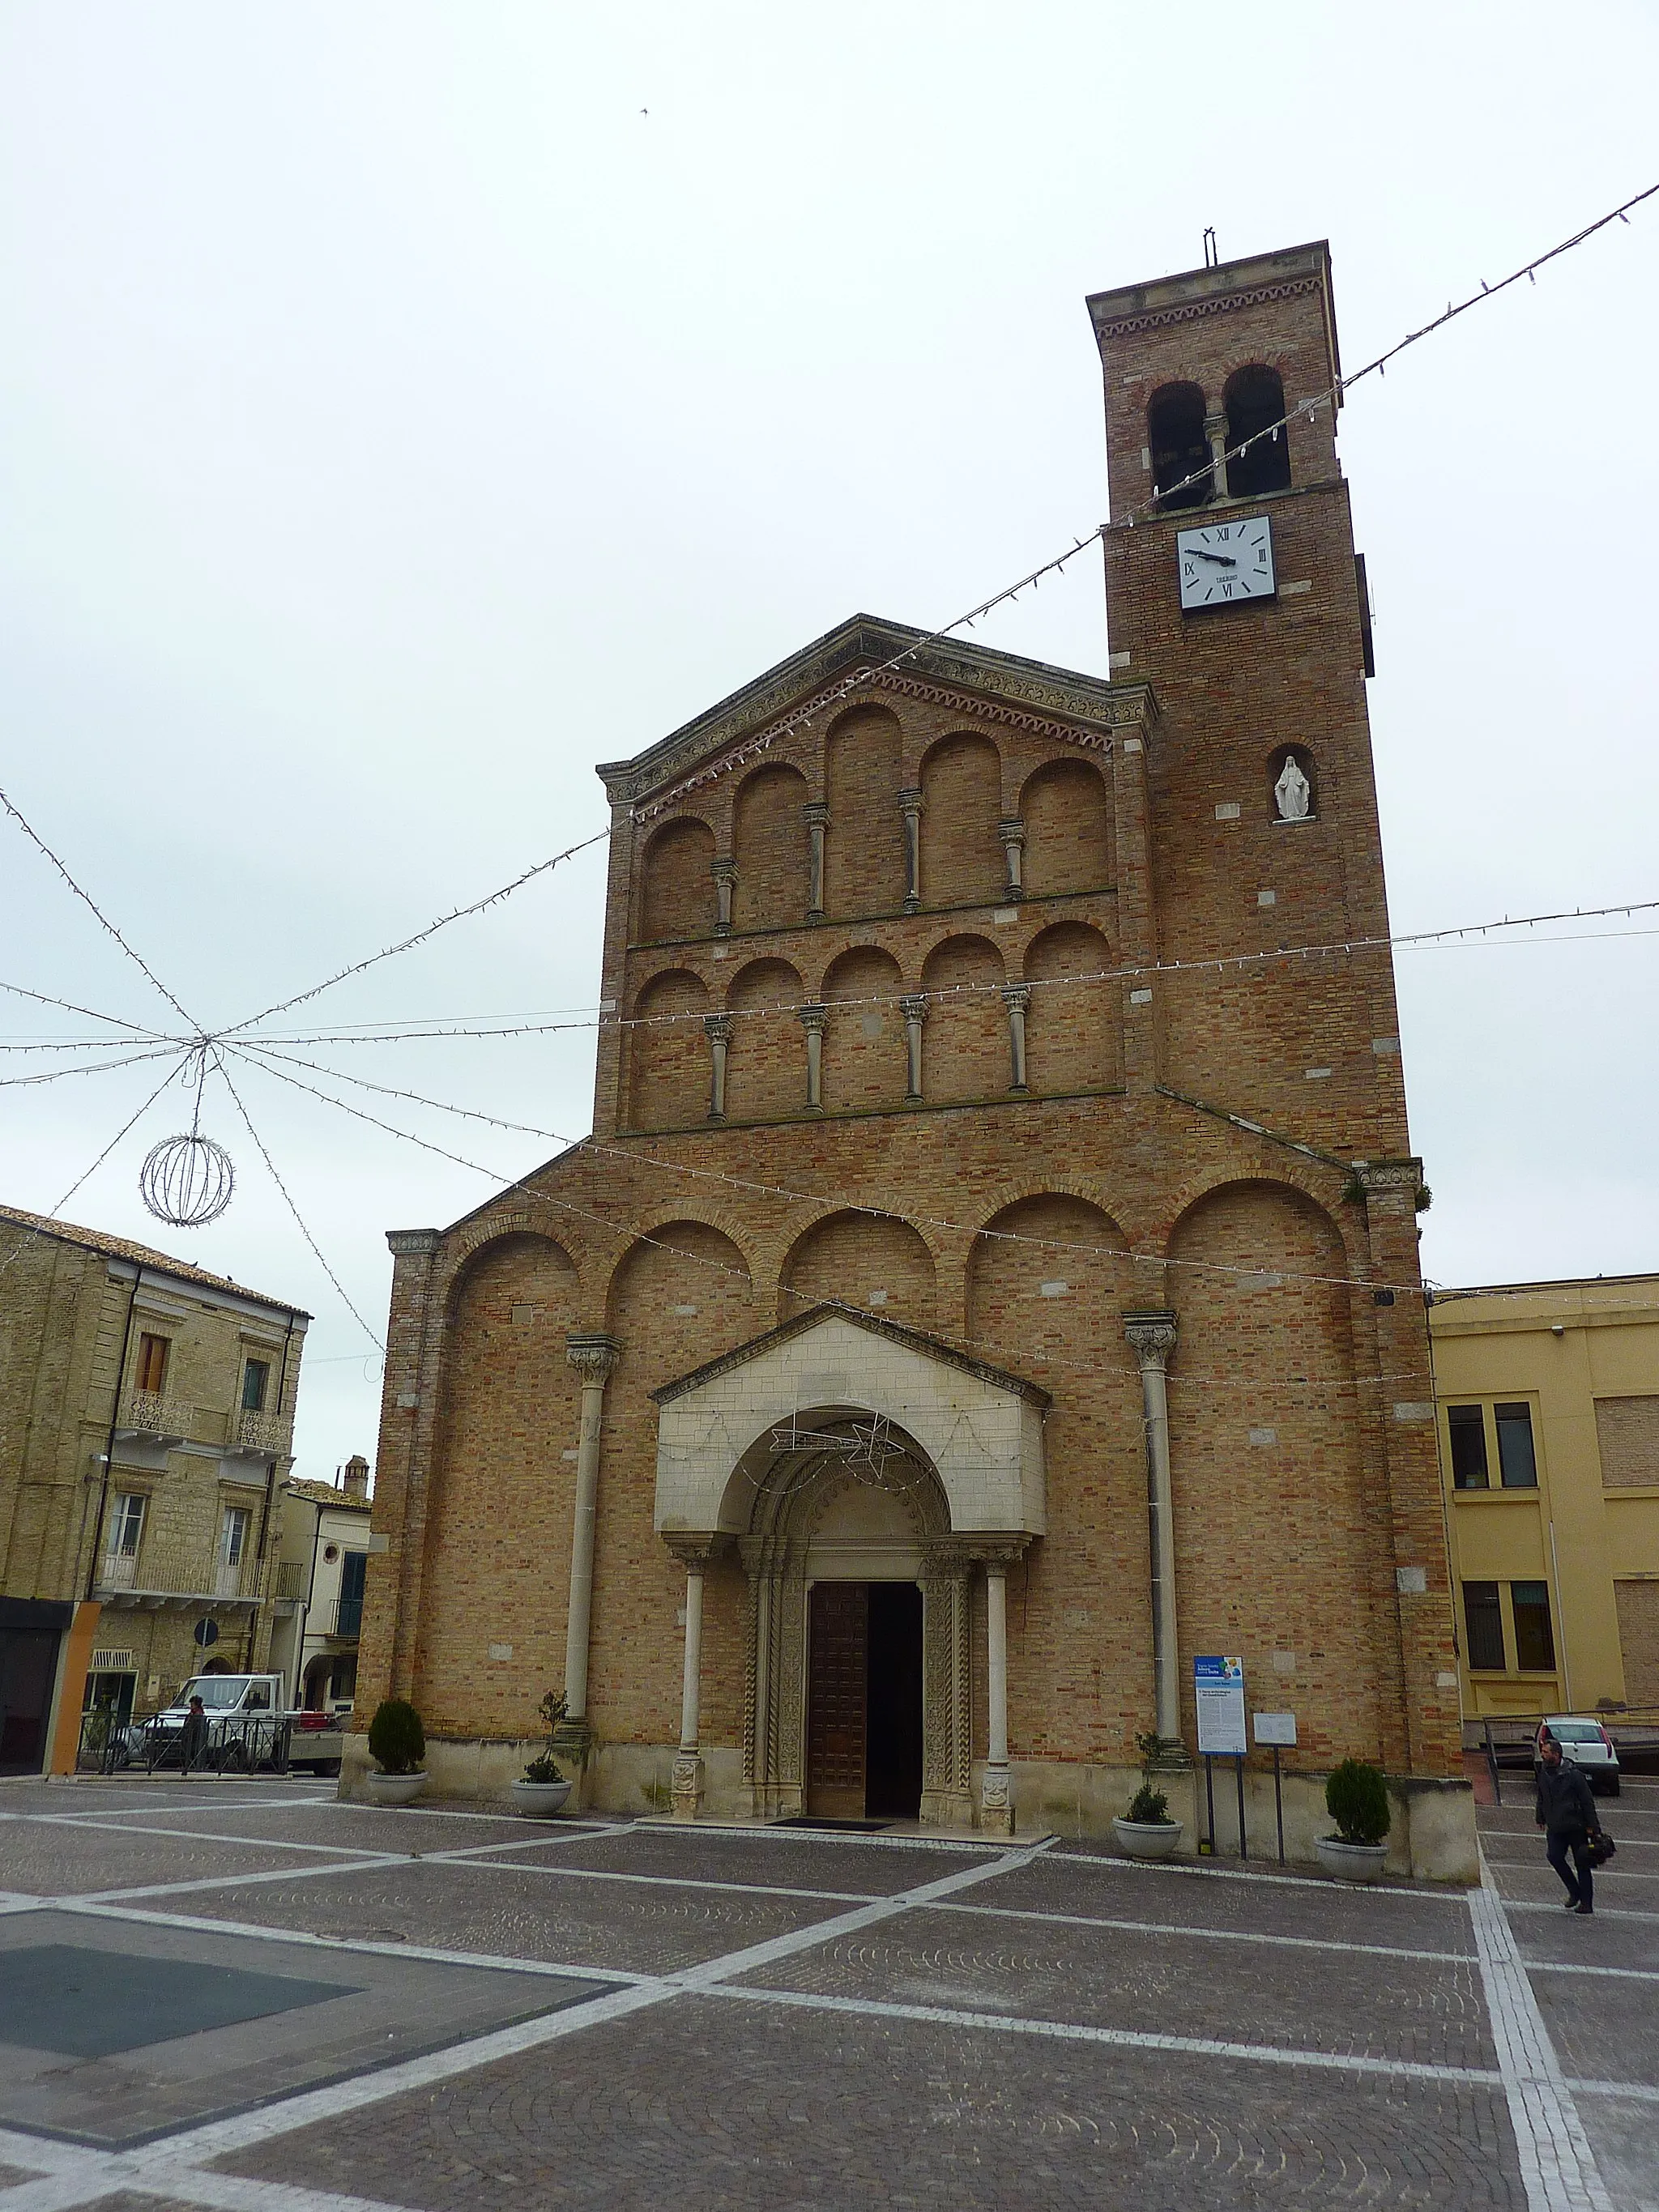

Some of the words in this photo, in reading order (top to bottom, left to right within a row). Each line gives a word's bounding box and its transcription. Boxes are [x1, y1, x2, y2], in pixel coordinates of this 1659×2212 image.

[1217, 527, 1230, 542] XII
[1258, 548, 1266, 562] III
[1184, 561, 1195, 576] IX
[1222, 583, 1232, 597] VI
